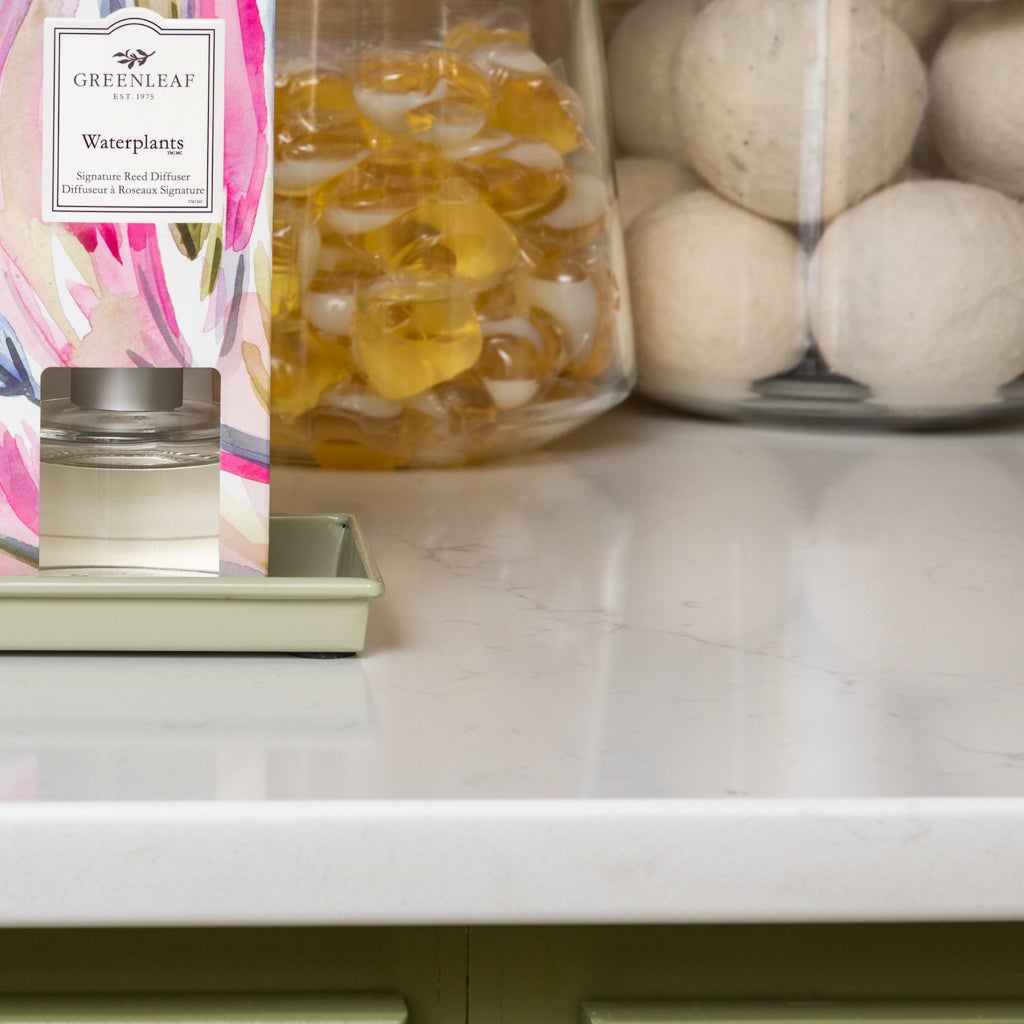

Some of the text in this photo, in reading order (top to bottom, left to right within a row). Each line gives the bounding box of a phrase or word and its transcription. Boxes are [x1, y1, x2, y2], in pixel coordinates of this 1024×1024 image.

[73, 72, 195, 88] GREENLEAF
[82, 134, 184, 154] Waterplants
[76, 171, 191, 183] Signature Reed Diffuser
[61, 184, 205, 197] Diffuseur à Roseaux Signature
